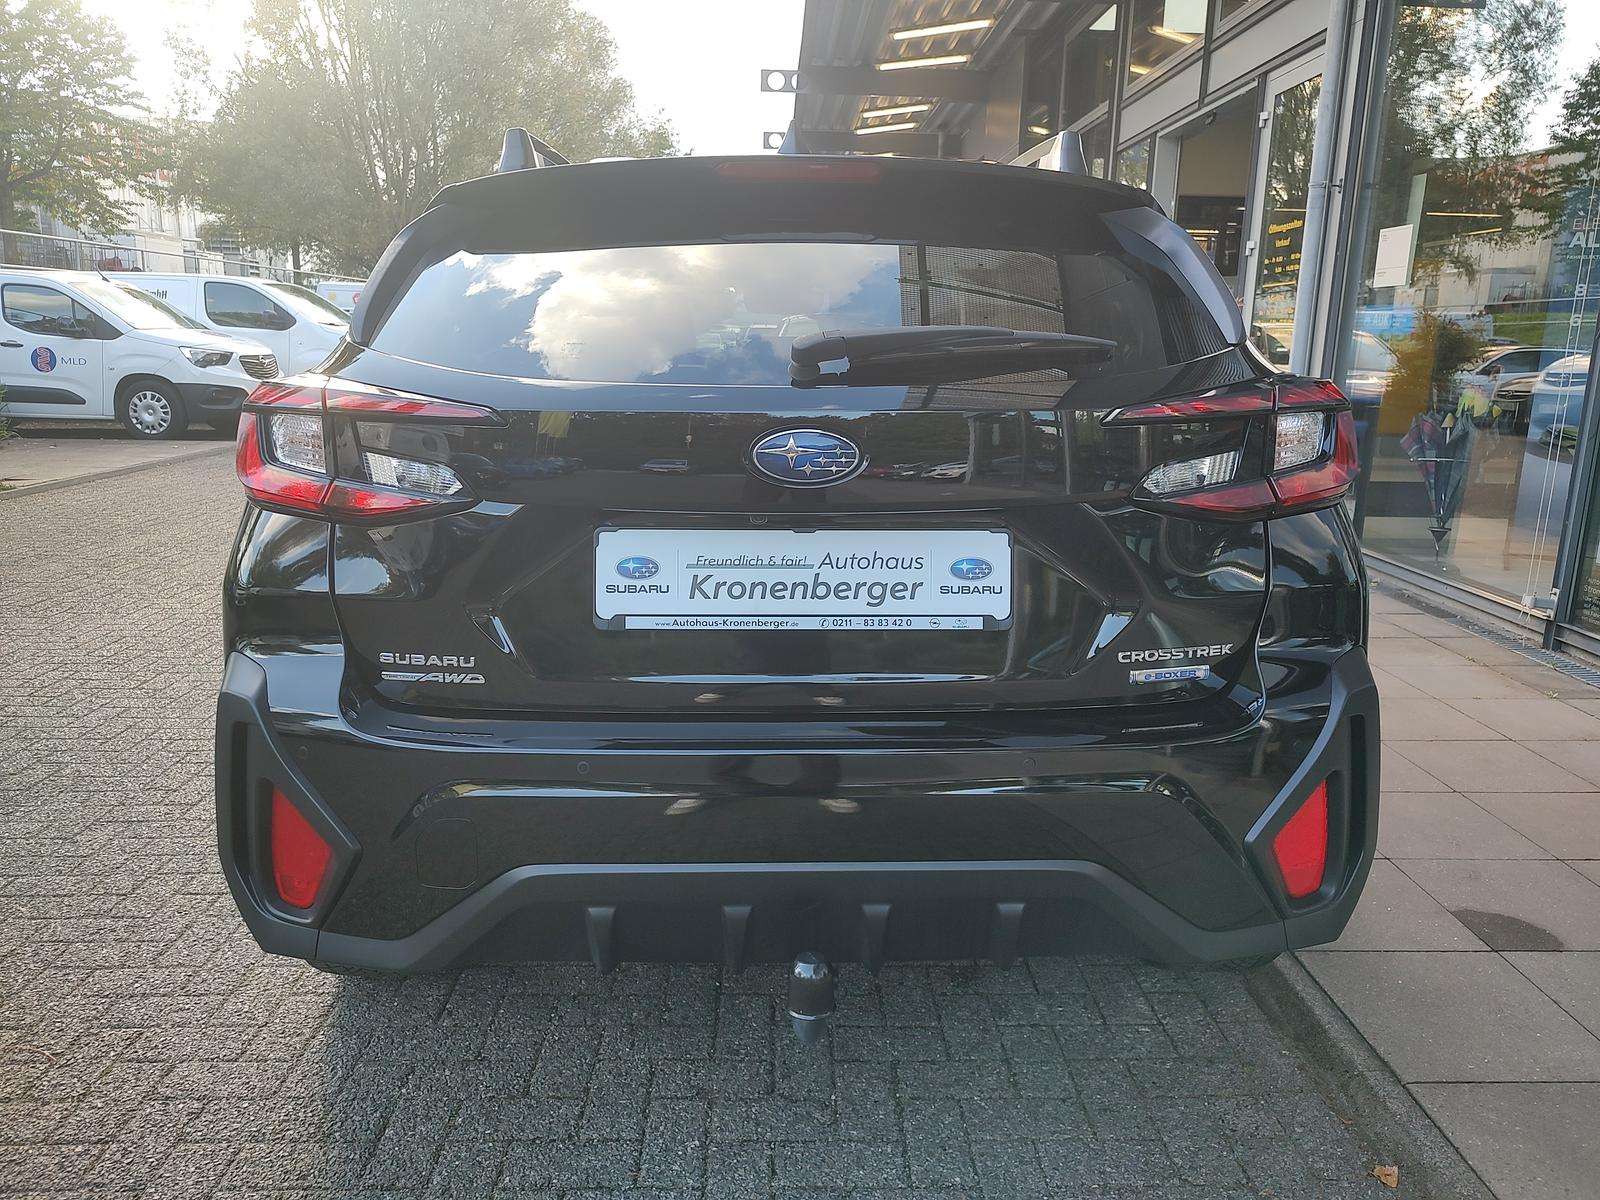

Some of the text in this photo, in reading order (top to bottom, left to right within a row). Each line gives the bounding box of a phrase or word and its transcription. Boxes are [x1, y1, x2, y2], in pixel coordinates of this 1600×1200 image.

[61, 357, 87, 366] MLD
[696, 551, 924, 570] Freundlich & fair! Autohaus
[605, 584, 670, 594] SUBARU
[689, 573, 924, 608] Kronenberger
[939, 585, 1003, 595] SUBARU
[654, 618, 799, 629] www.Autohaus-Kronenberger.de
[832, 617, 853, 627] 0211
[863, 617, 875, 627] 83
[877, 617, 889, 627] 83
[891, 617, 904, 627] 42
[905, 617, 912, 627] 0
[1118, 643, 1234, 663] CROSSTREK
[379, 652, 475, 667] SUBARU
[418, 672, 486, 684] AWD
[1144, 669, 1198, 681] e-BOXER
